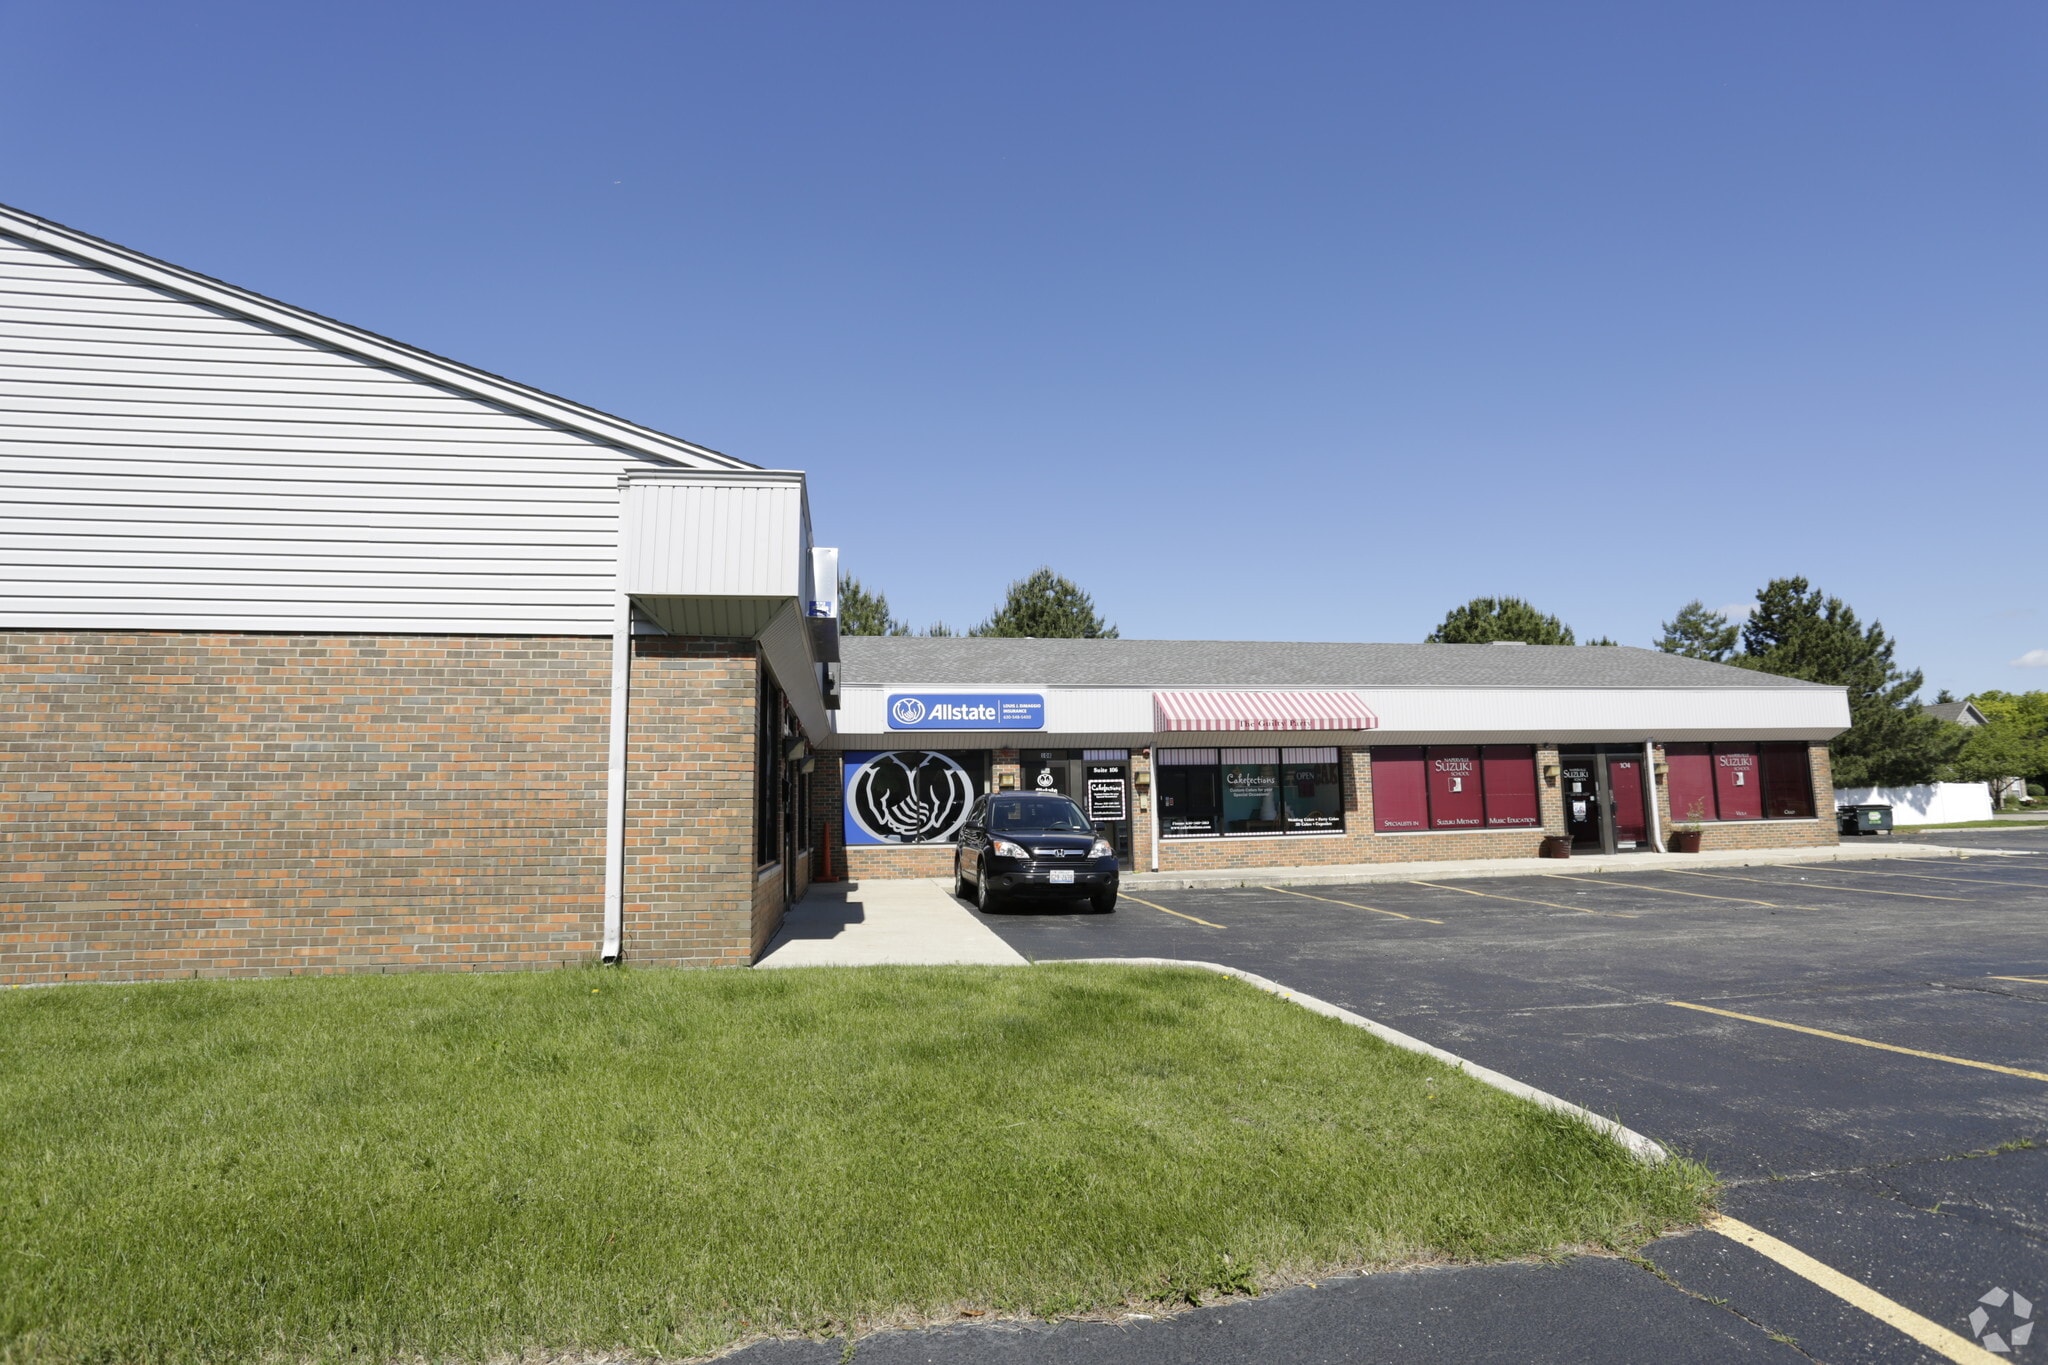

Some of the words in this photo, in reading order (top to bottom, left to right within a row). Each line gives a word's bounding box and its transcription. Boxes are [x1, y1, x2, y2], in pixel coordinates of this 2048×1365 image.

[928, 704, 995, 720] Allstate
[1240, 720, 1254, 728] The
[1258, 719, 1285, 728] Guilty
[1290, 719, 1312, 728] Party
[1435, 760, 1472, 771] SUZUKI
[1720, 756, 1752, 767] SUZUKI
[1296, 772, 1315, 780] OPEN
[1563, 769, 1589, 778] SUZUKI
[1226, 773, 1275, 786] Cakefections
